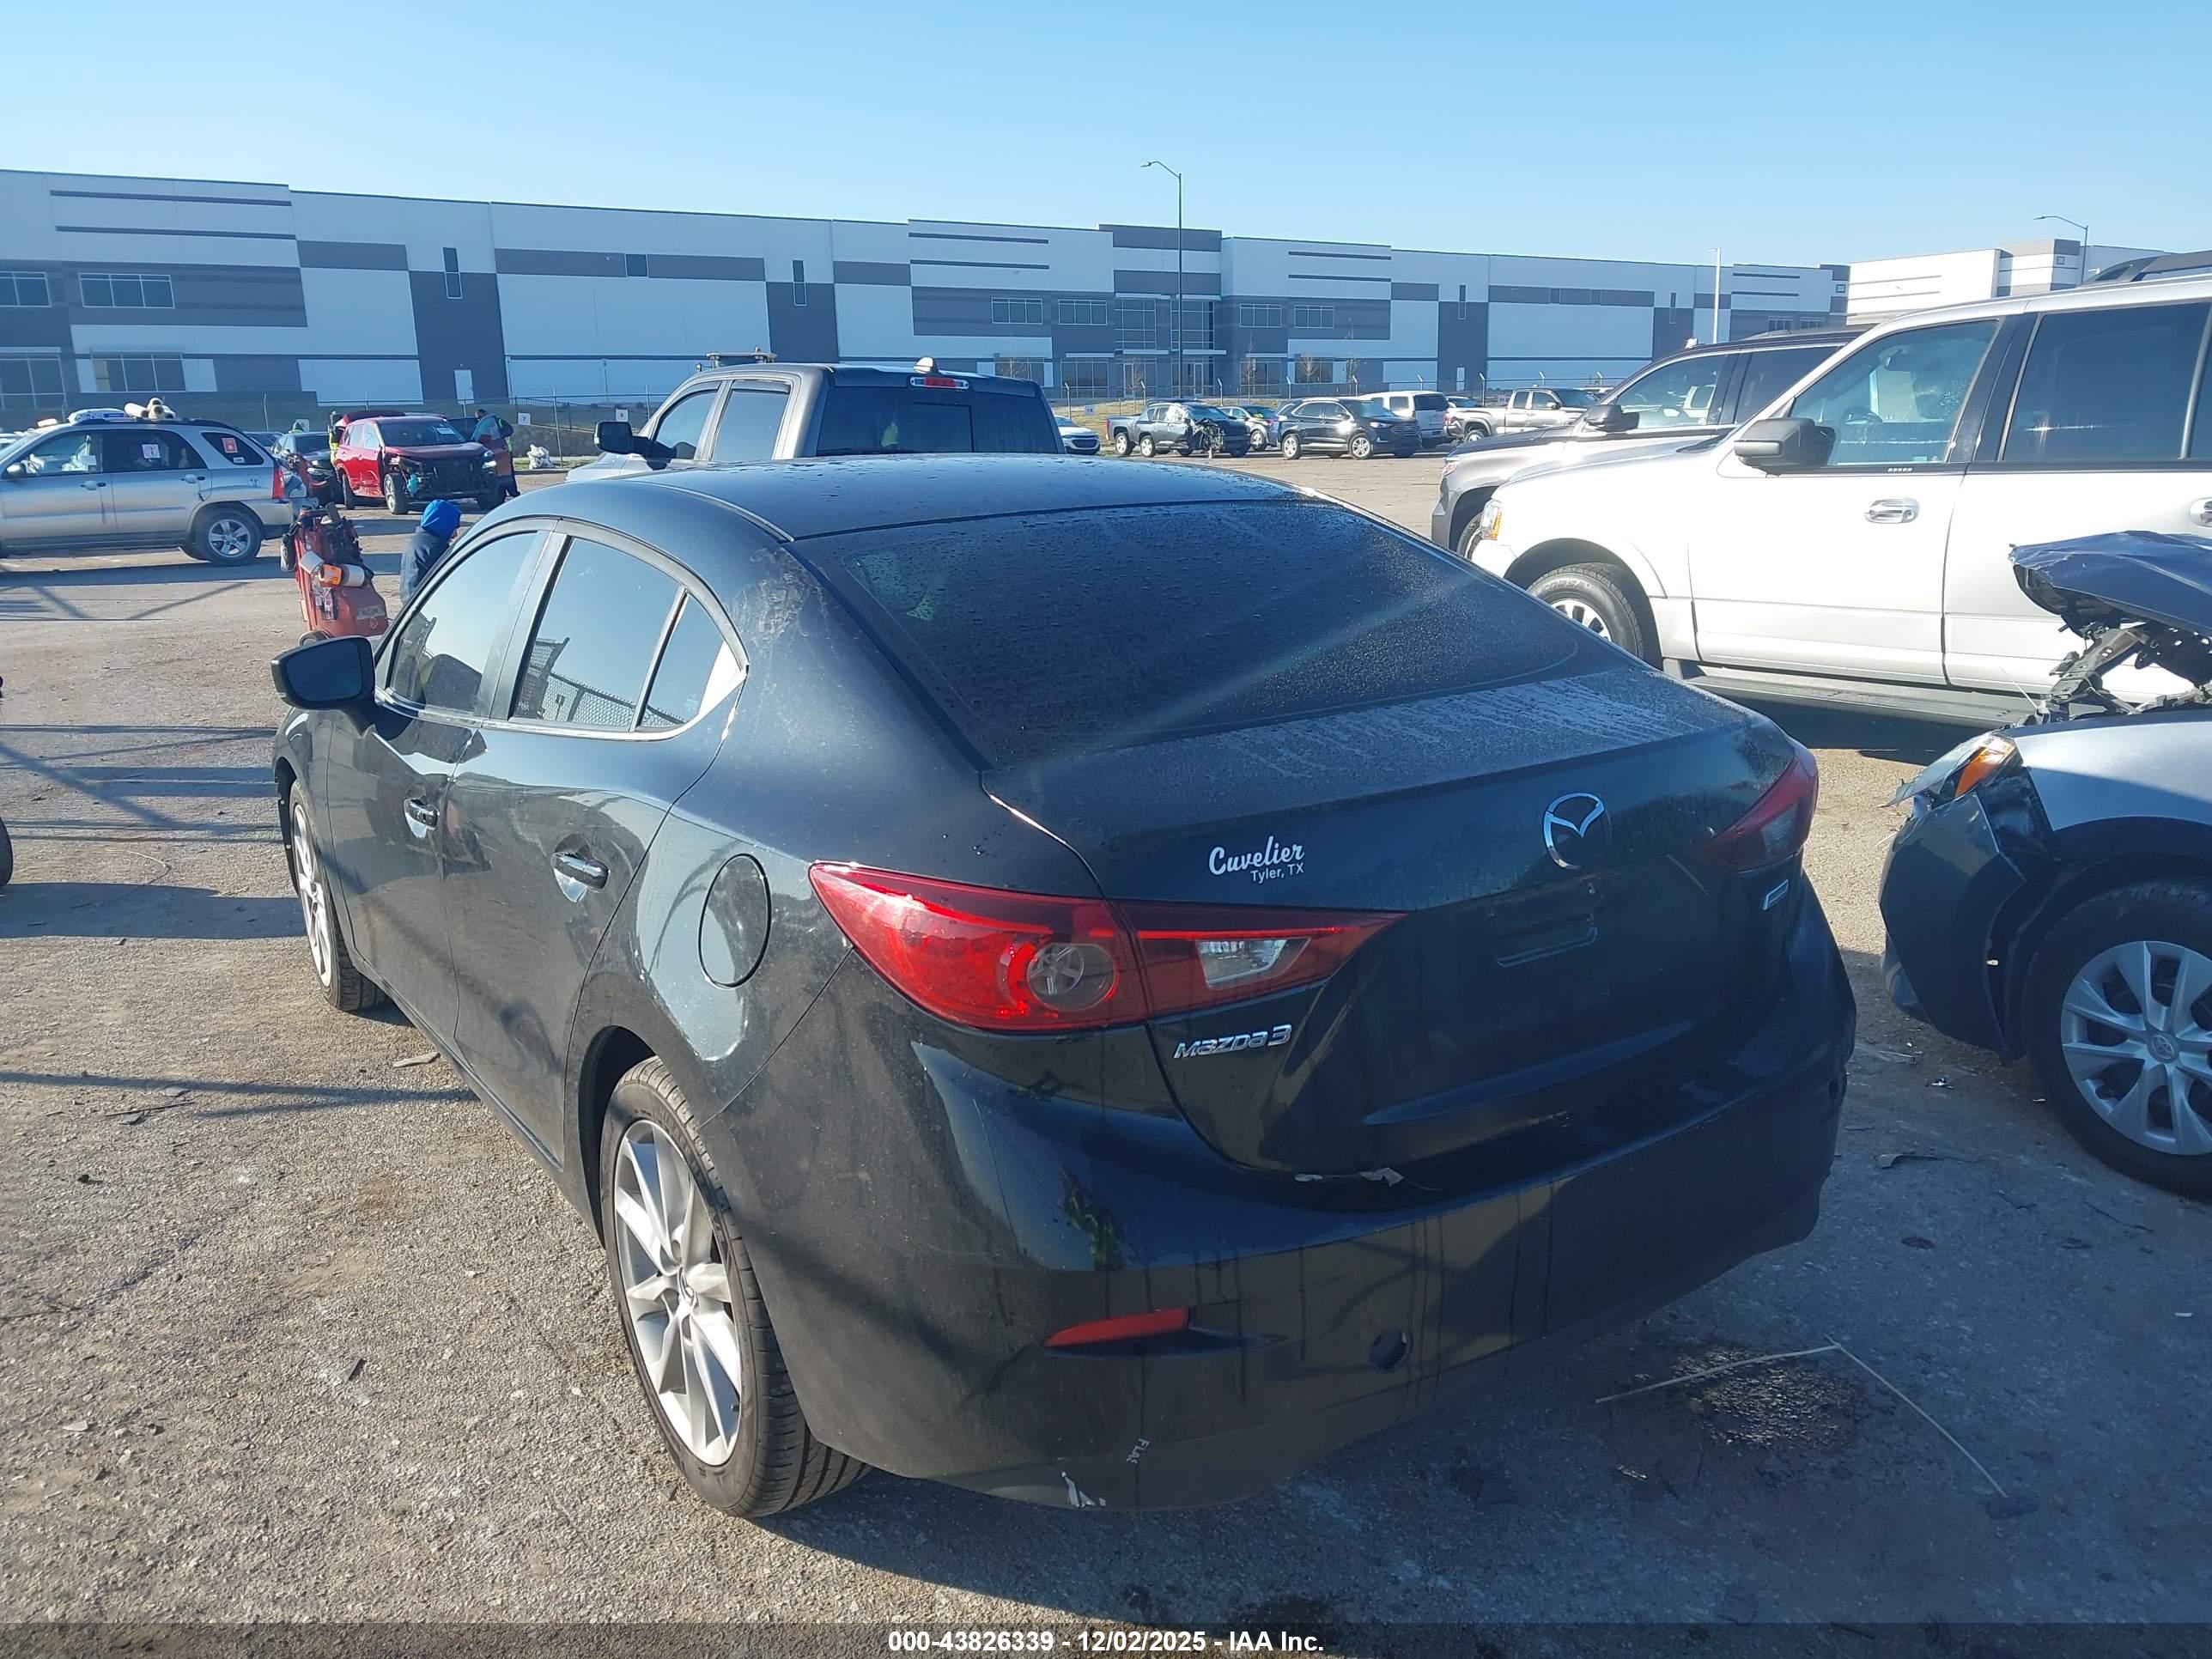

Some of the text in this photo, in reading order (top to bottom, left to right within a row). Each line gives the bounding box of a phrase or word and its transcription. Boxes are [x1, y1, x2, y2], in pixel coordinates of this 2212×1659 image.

[1209, 836, 1304, 876] Cuvelier
[1250, 862, 1304, 884] Tyler, TX
